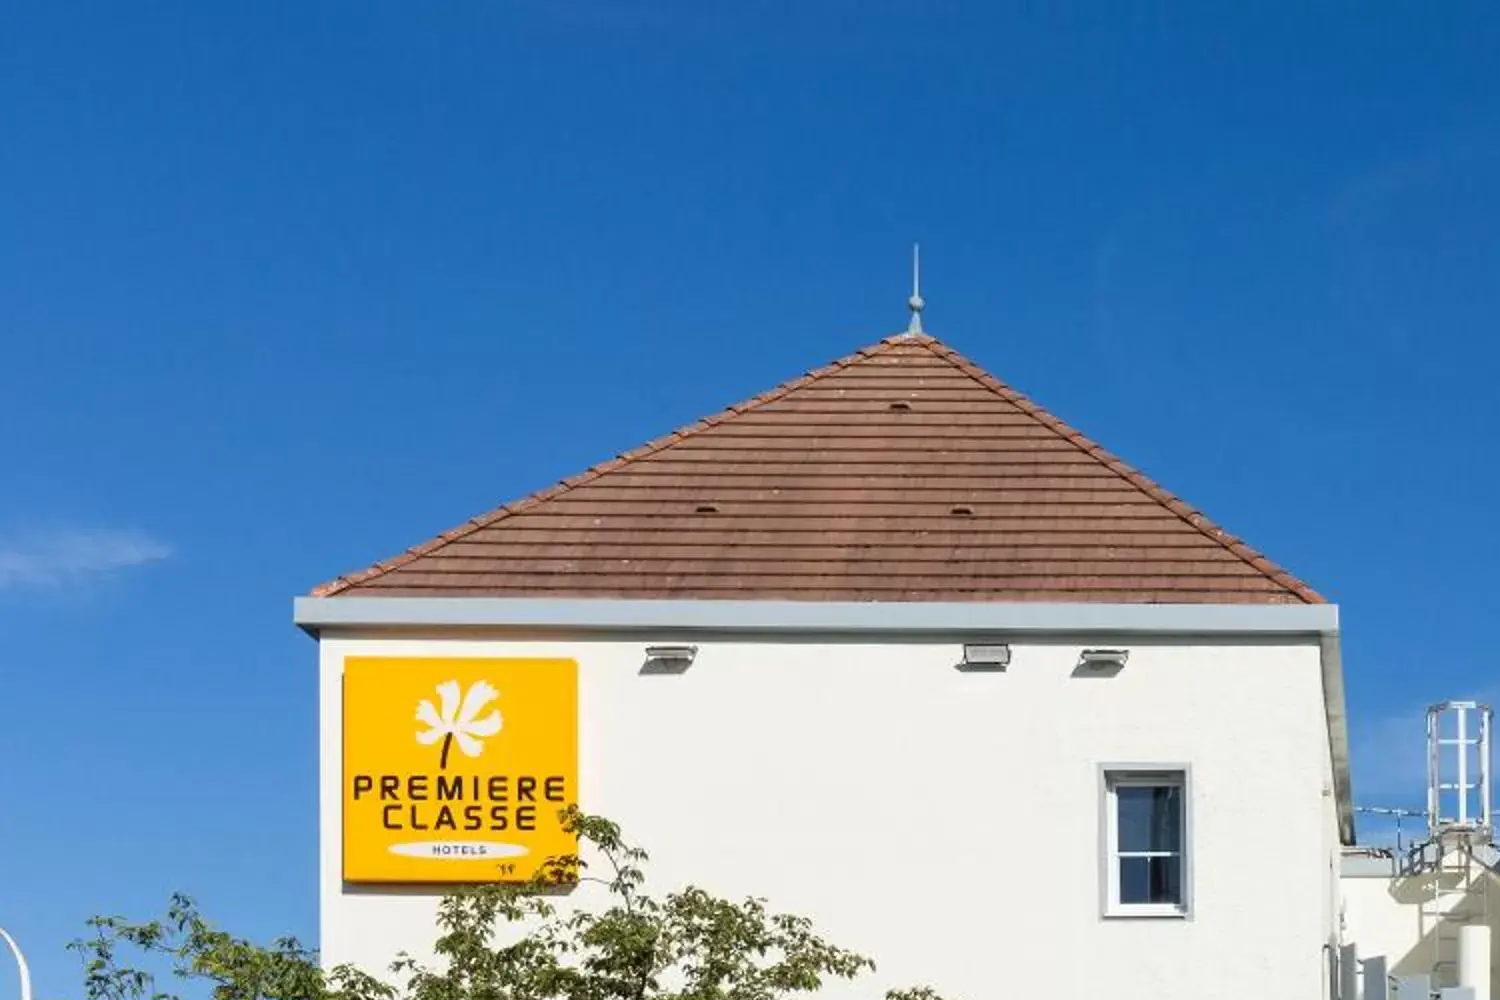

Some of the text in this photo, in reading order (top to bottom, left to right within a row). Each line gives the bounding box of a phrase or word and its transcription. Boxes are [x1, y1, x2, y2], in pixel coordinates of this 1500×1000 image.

[353, 775, 565, 802] PREMIERE
[383, 804, 536, 831] CLASSE
[432, 844, 487, 855] HOTELS
